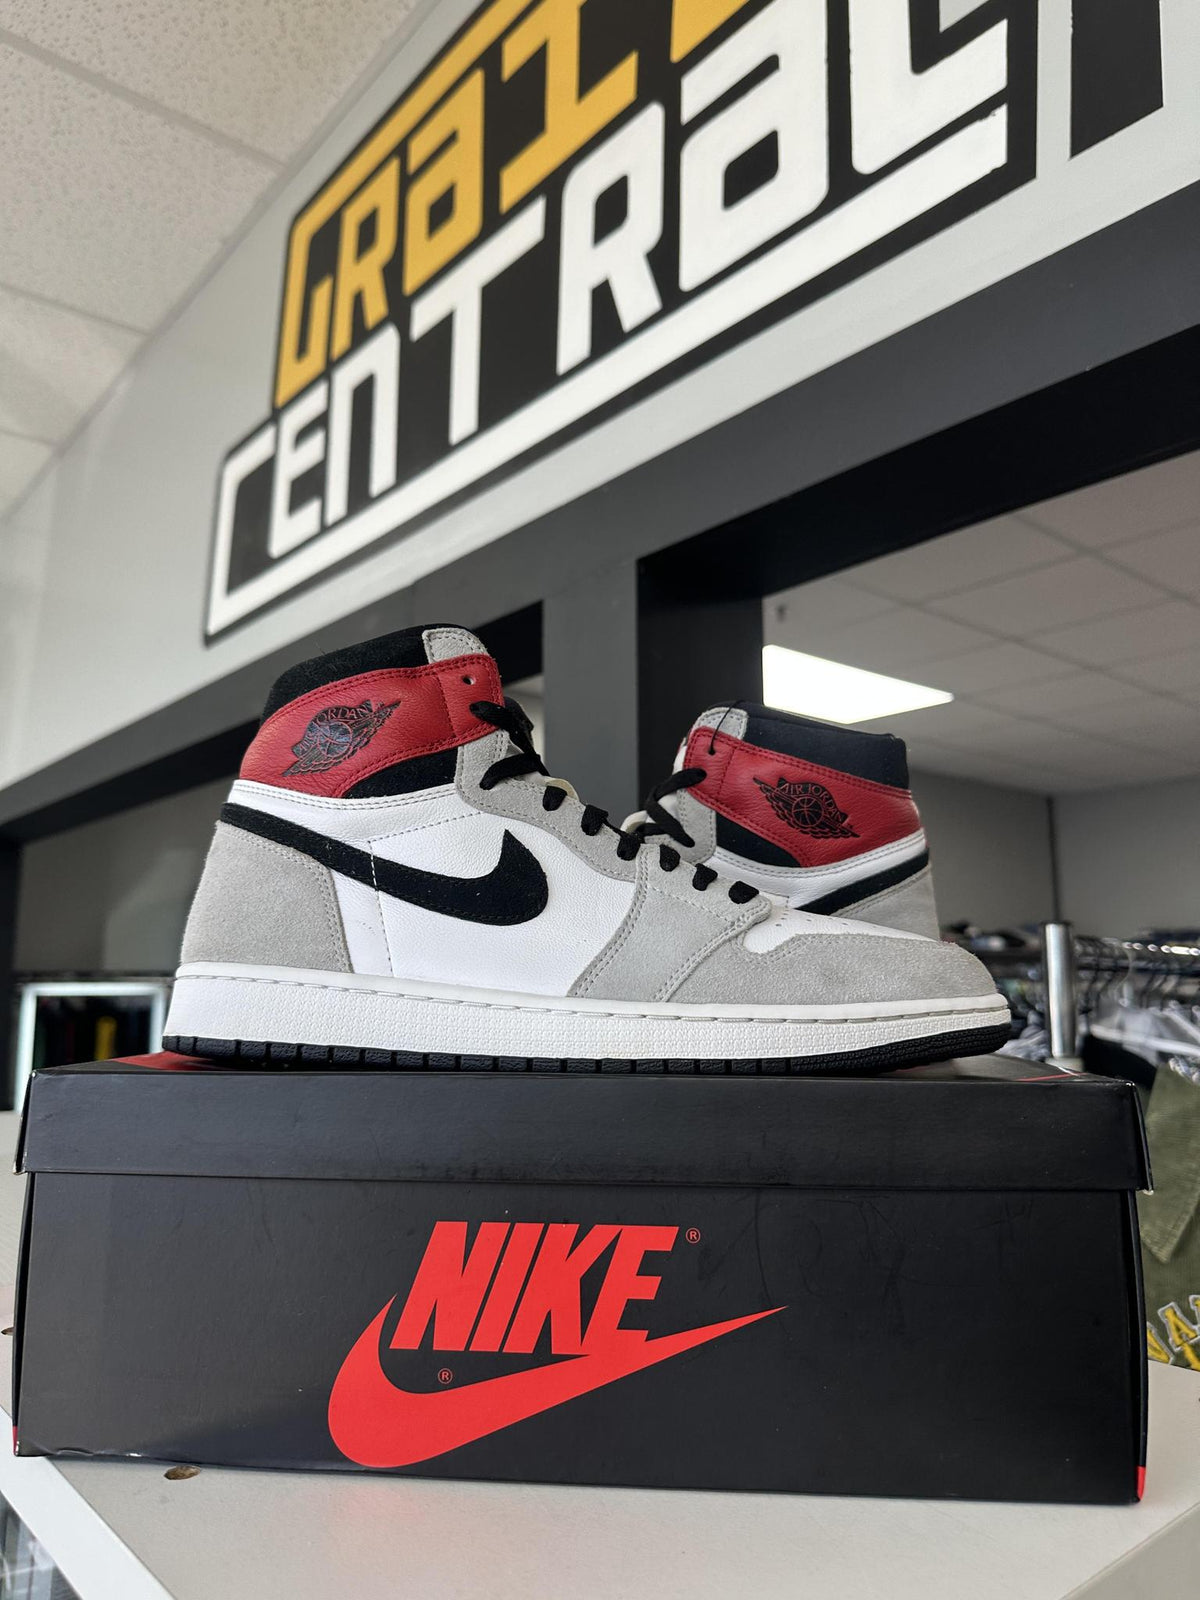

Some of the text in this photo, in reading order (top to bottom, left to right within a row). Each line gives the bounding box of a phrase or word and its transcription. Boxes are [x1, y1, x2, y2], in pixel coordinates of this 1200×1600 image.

[780, 782, 843, 822] AIR JORDAN
[389, 1221, 679, 1355] NIKE
